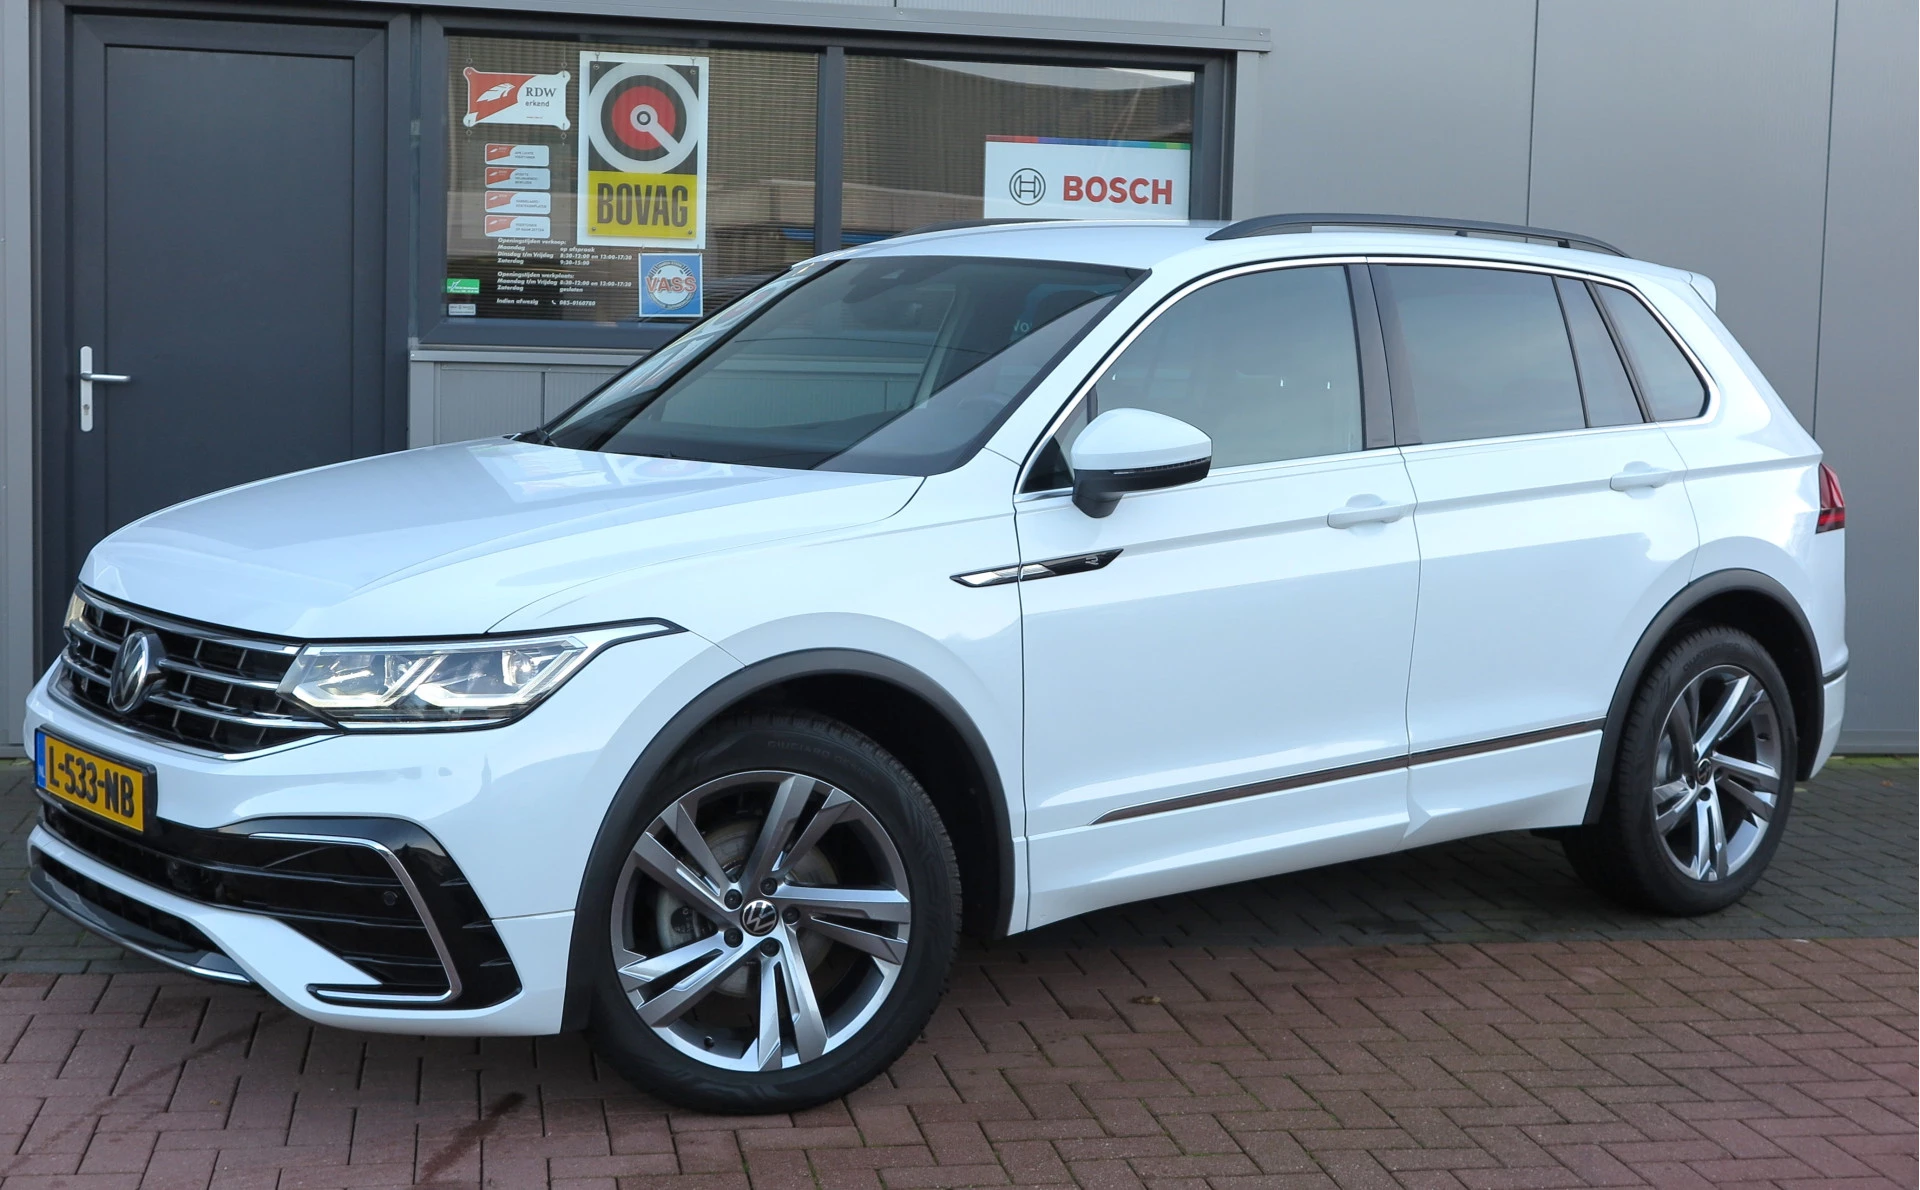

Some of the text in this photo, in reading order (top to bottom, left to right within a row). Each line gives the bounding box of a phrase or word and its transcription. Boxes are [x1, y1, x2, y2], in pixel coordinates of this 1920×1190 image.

[525, 87, 557, 98] RDW
[1063, 175, 1172, 205] BOSCH
[597, 183, 688, 227] BOVAG
[497, 237, 540, 246] Openingstijden
[497, 271, 575, 280] Openingstijden werkplaats:
[645, 275, 697, 293] VASS
[49, 746, 134, 818] L-533-NB
